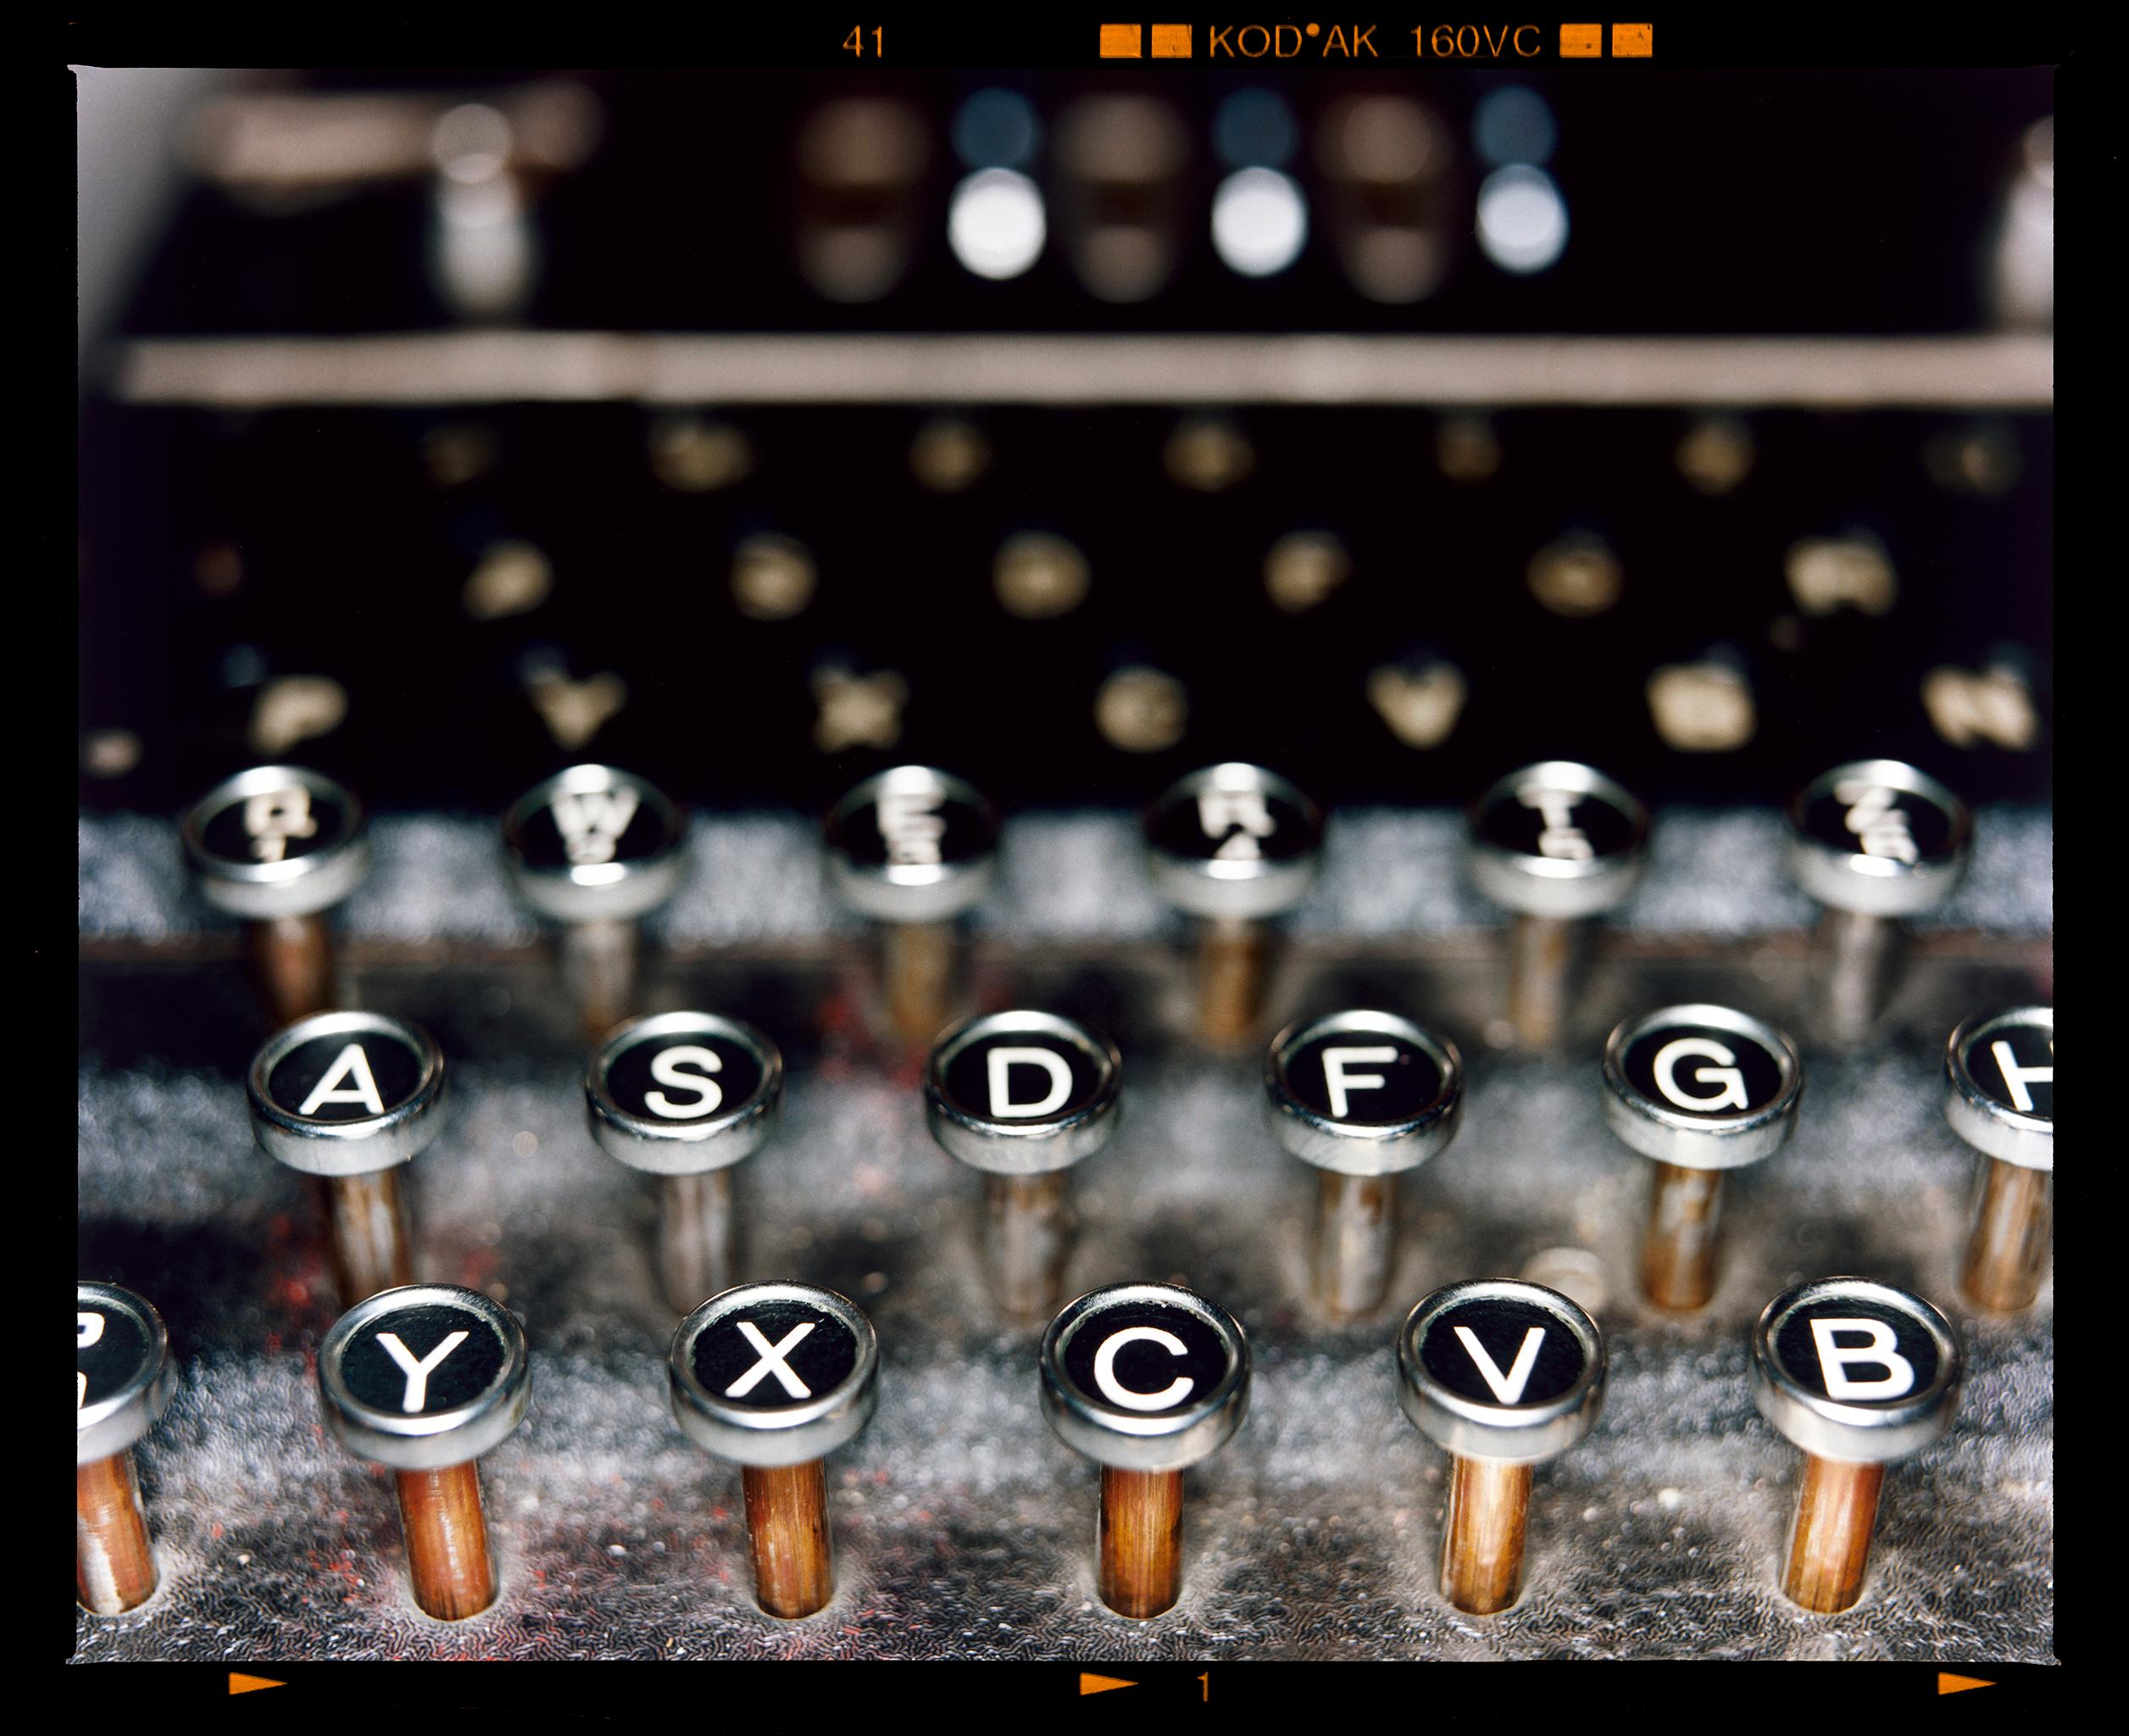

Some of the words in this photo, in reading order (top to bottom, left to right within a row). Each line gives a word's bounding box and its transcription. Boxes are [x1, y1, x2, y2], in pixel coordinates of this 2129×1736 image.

[299, 1043, 385, 1115] A
[645, 1046, 722, 1119] S
[988, 1048, 1072, 1118] D
[1322, 1047, 1397, 1117] F
[1654, 1038, 1748, 1111] G
[375, 1331, 470, 1413] Y
[725, 1321, 815, 1399] X
[1093, 1326, 1194, 1411] C
[1454, 1326, 1546, 1405] V
[1809, 1318, 1915, 1400] B
